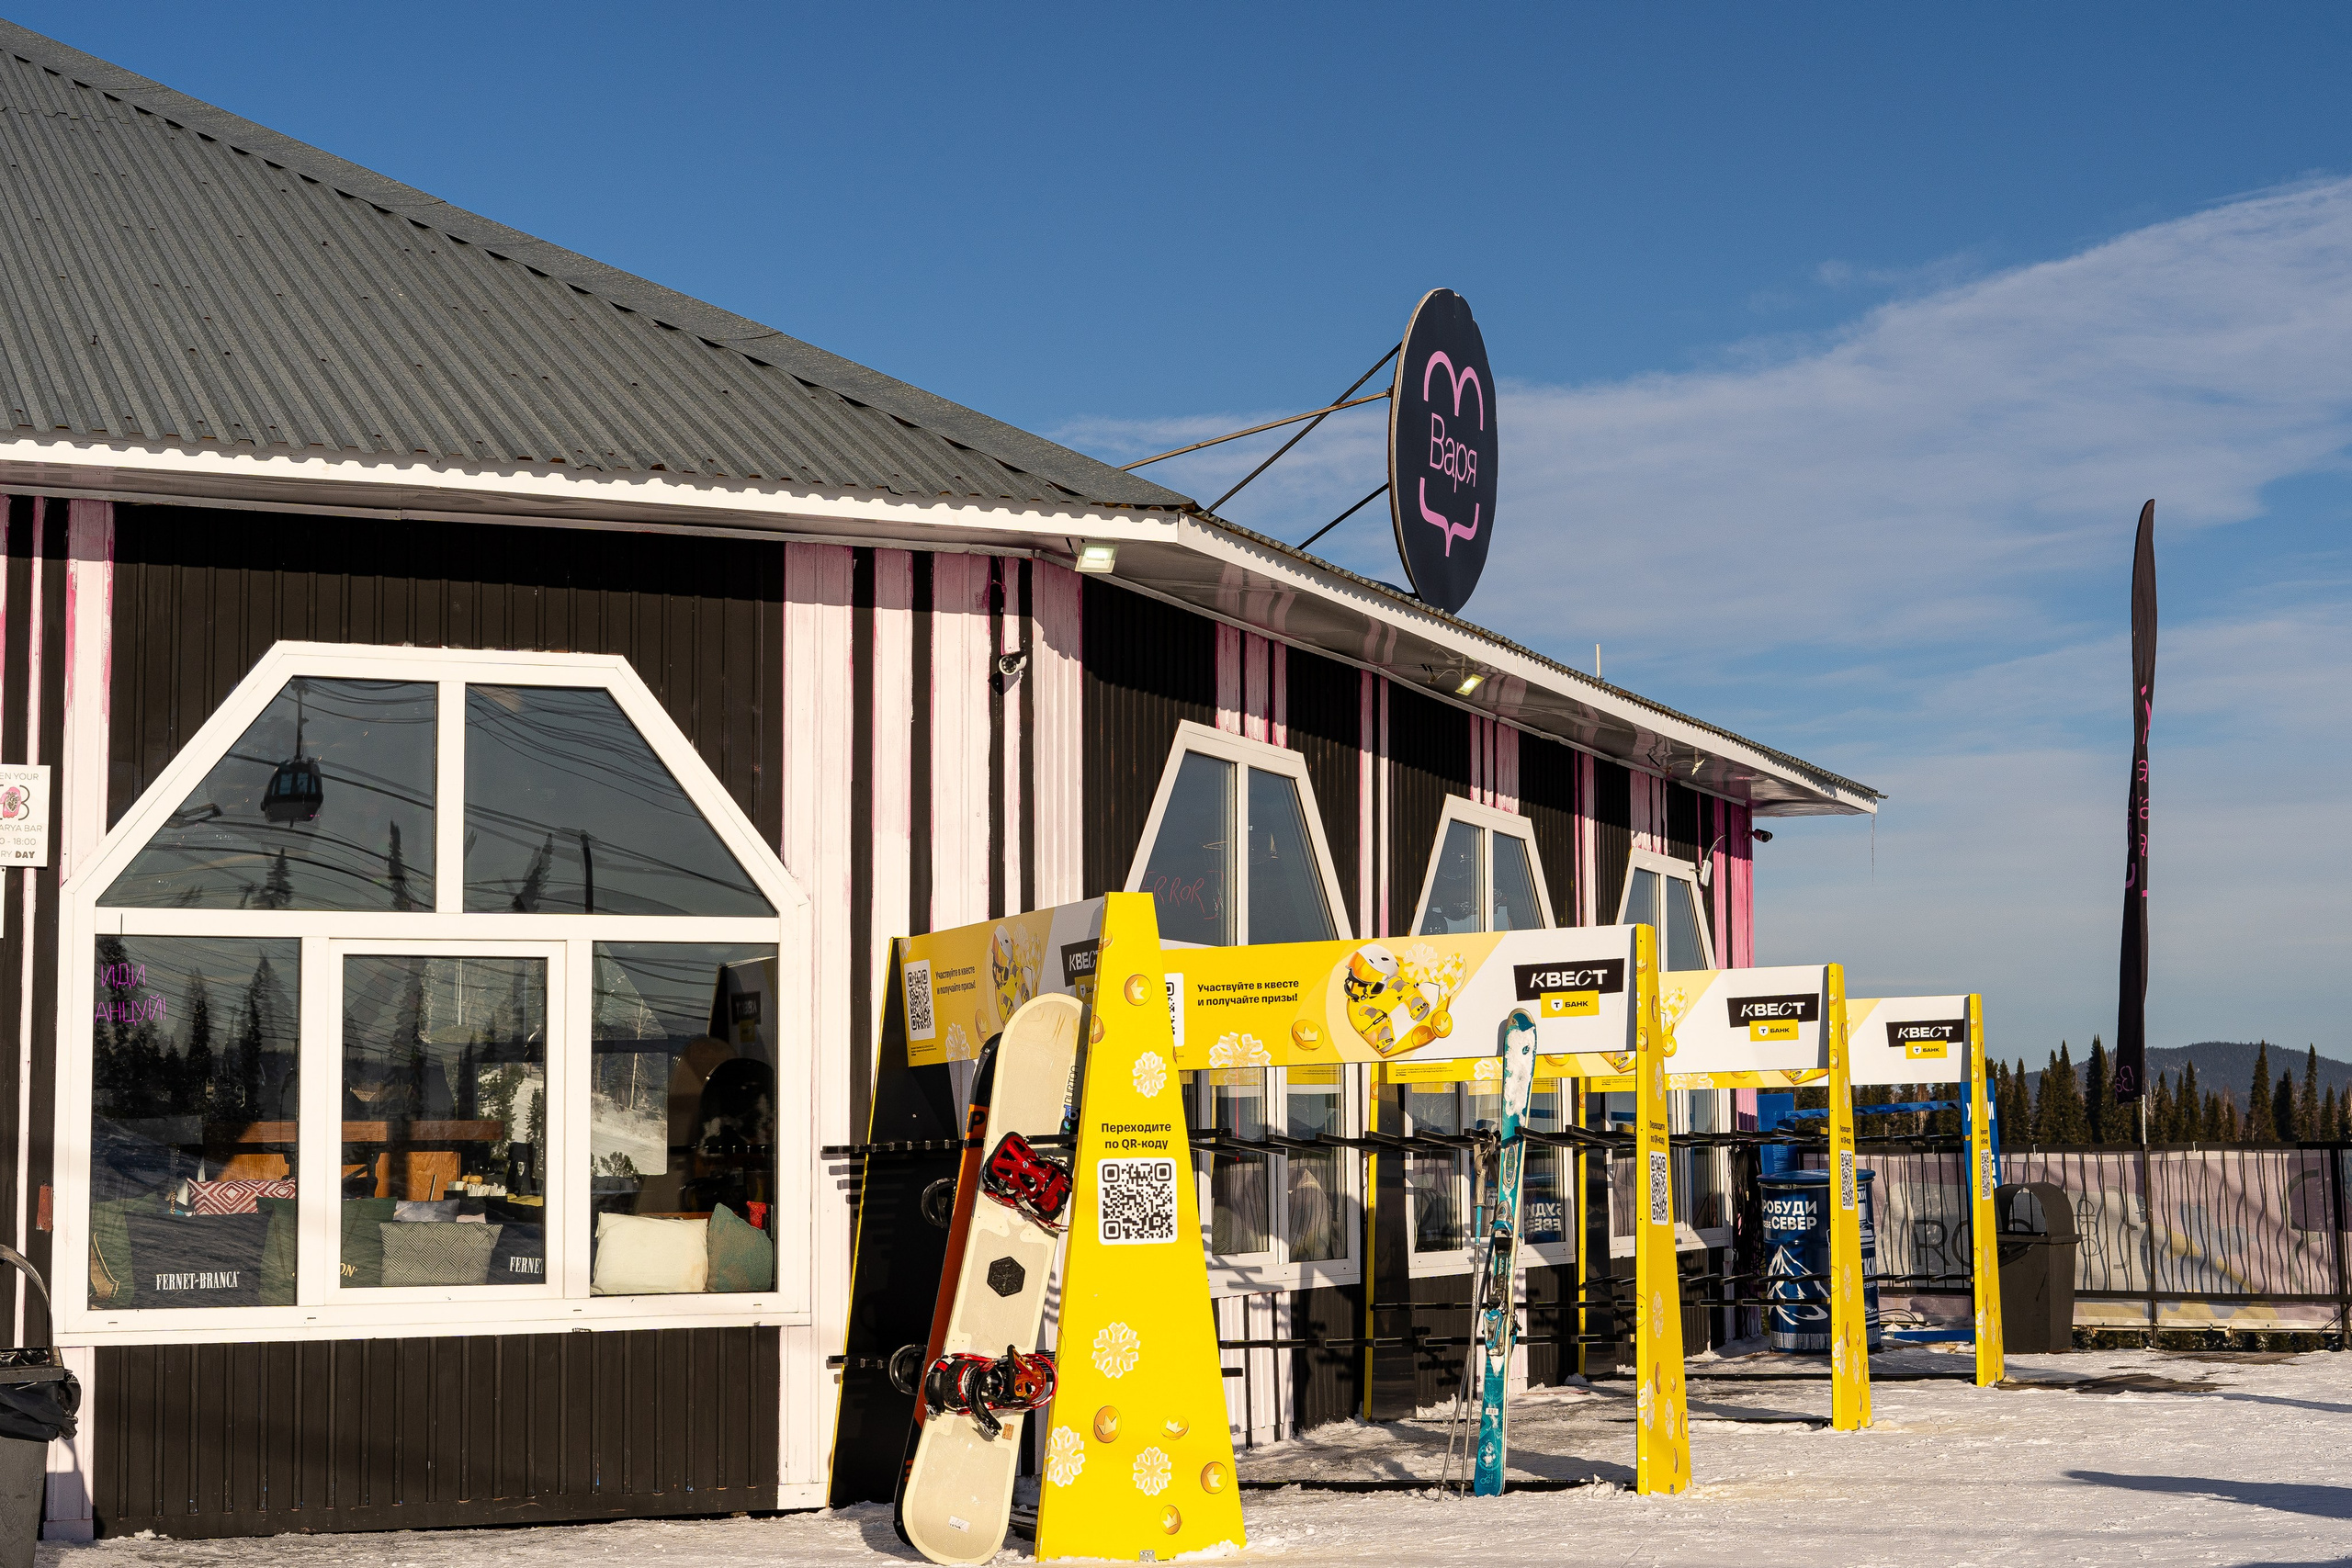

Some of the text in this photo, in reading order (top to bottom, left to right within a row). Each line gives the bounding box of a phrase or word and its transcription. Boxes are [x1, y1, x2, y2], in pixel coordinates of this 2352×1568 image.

[1430, 412, 1478, 493] Варя
[13, 838, 37, 846] 18:00
[15, 851, 35, 859] DAY
[100, 963, 146, 990] ИДИ
[1529, 969, 1608, 988] КВЕСТ
[1197, 981, 1255, 993] Участвуйте
[1264, 980, 1299, 989] квесте
[1197, 993, 1298, 1007] и получайте призы!
[1740, 1002, 1806, 1018] КВЕСТ
[1897, 1026, 1953, 1039] КВЕСТ
[1064, 1065, 1080, 1104] BURTON
[1101, 1122, 1171, 1134] Переходите
[1104, 1138, 1169, 1151] по QR-коду
[1771, 1216, 1817, 1231] СЕВЕР
[155, 1270, 239, 1291] FERNET-BRANCA
